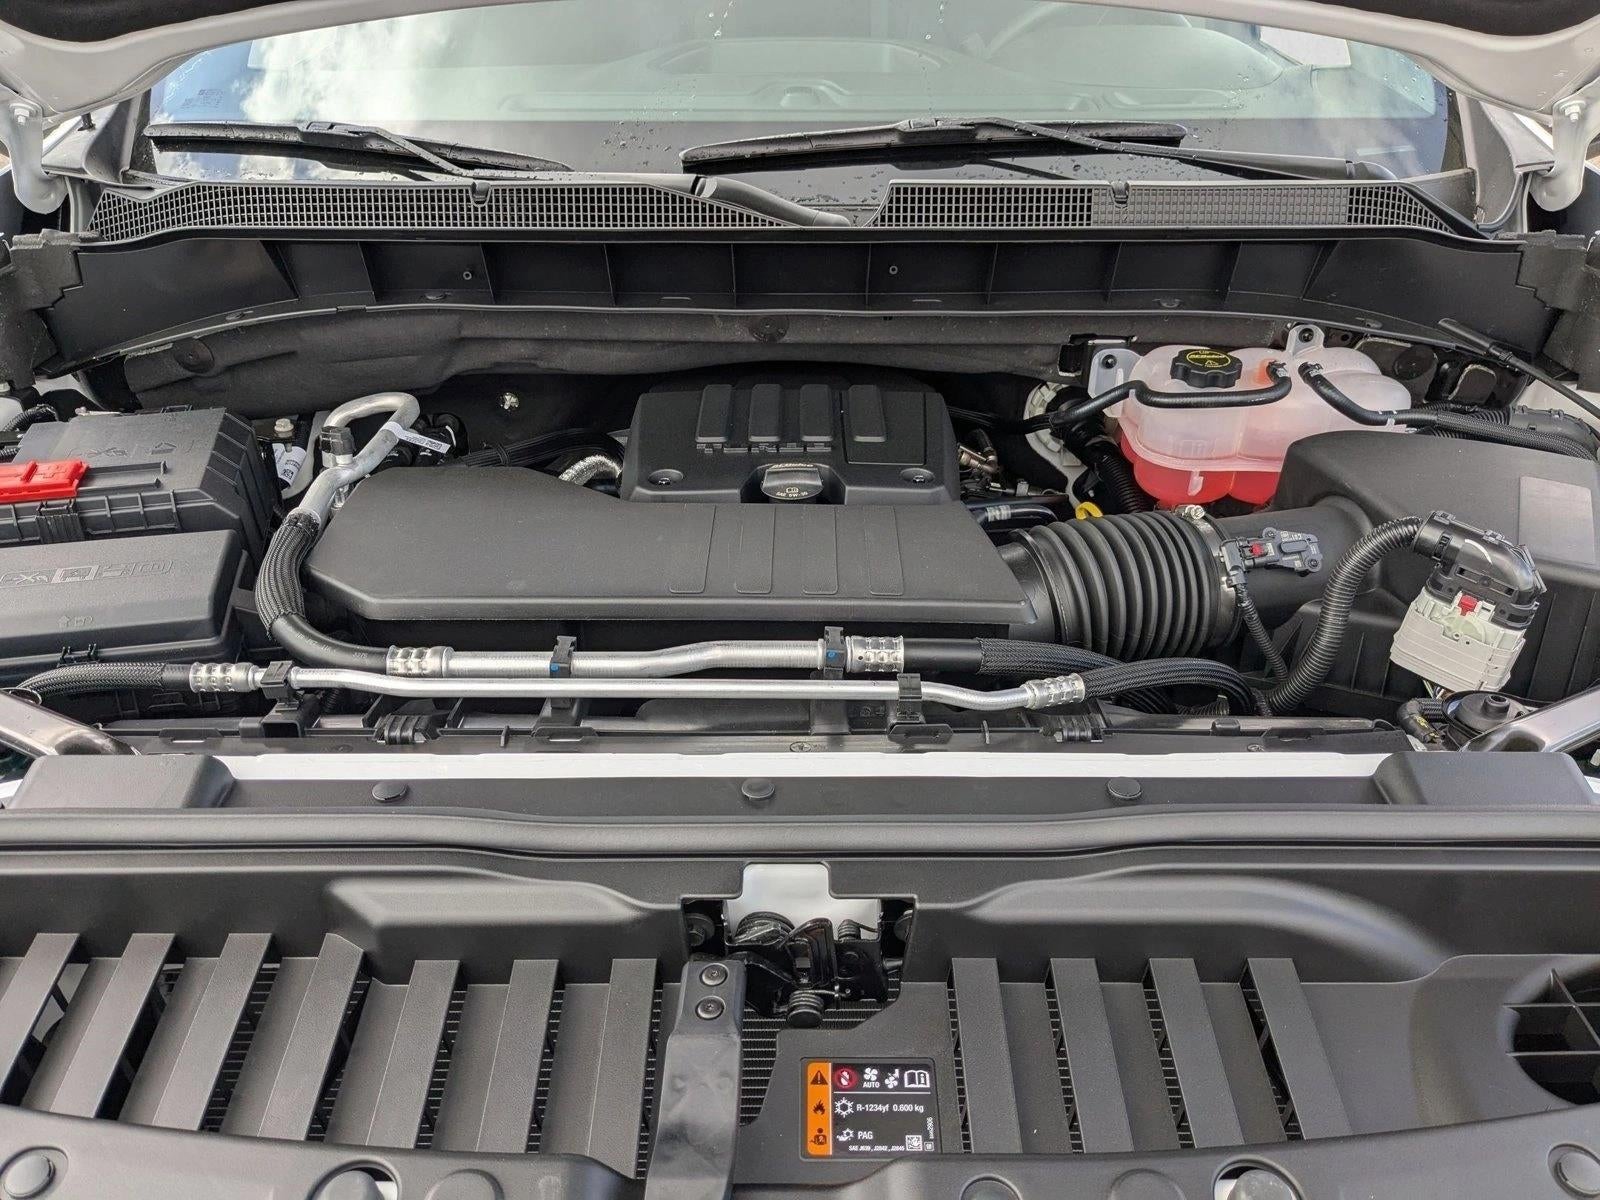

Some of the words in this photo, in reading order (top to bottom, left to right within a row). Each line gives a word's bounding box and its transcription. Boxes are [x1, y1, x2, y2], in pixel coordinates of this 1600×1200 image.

[856, 1104, 889, 1113] R-1234yf
[893, 1104, 913, 1112] 0.600
[915, 1104, 924, 1113] kg
[857, 1131, 873, 1140] PAG
